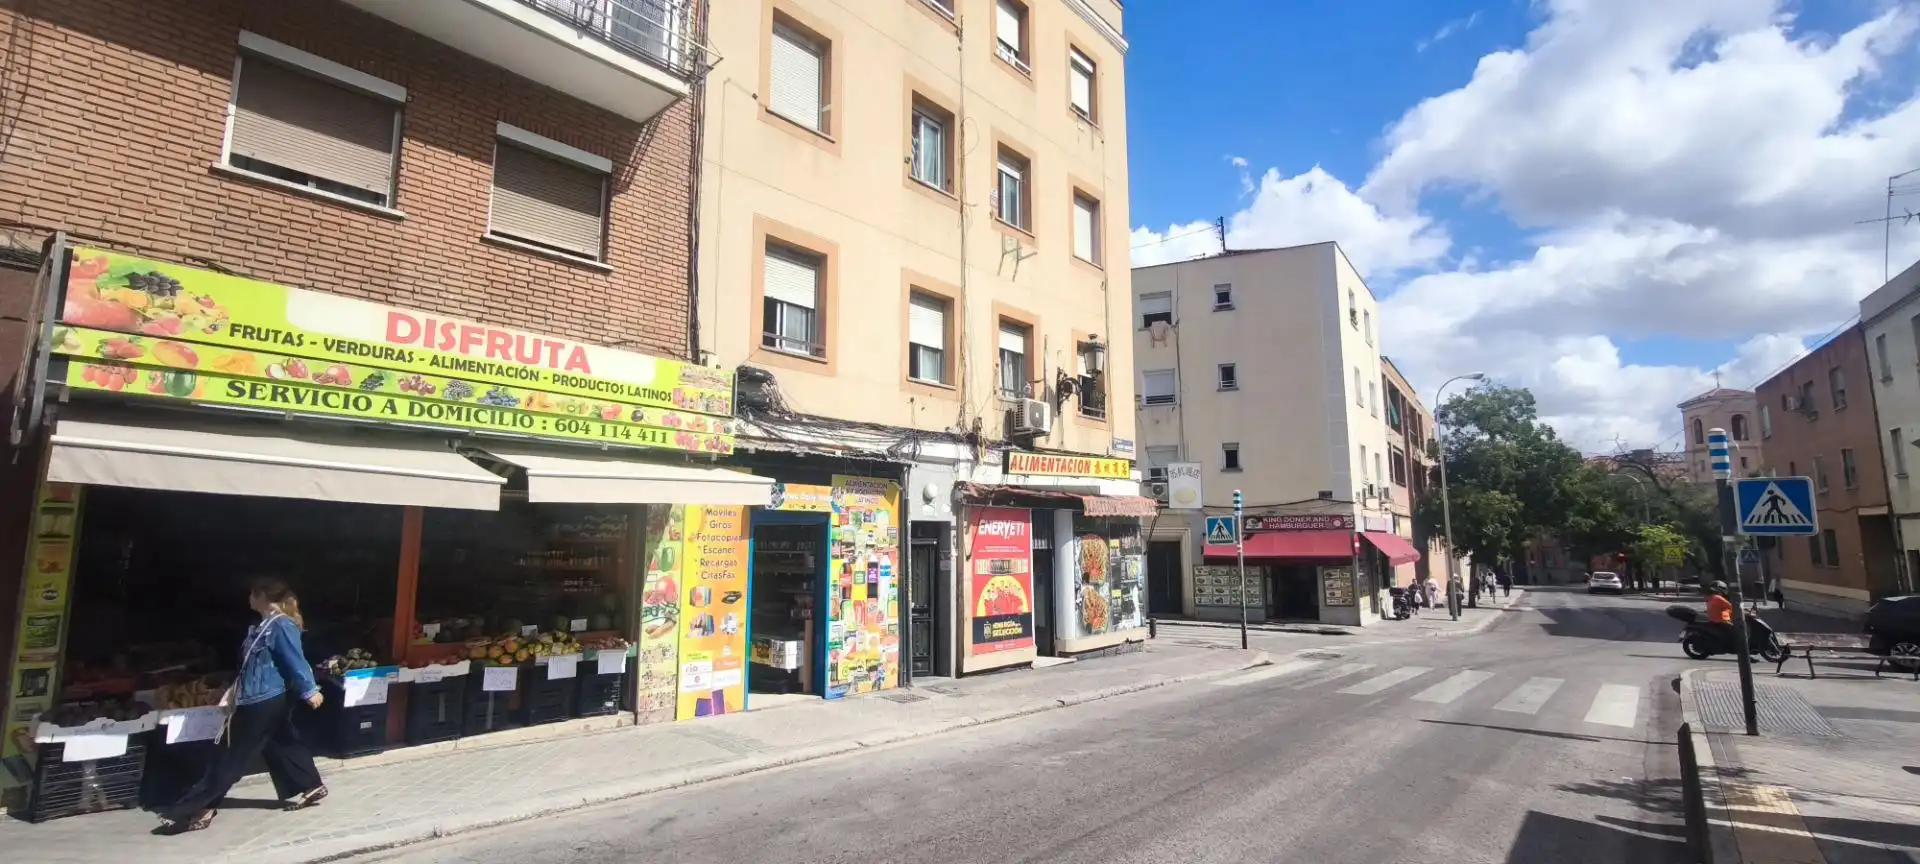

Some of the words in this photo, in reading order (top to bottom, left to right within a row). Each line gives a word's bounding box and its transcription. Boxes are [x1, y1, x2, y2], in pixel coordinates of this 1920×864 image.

[385, 310, 592, 374] DISFRUTA
[229, 322, 304, 348] FRUTAS
[323, 338, 414, 365] VERDURAS
[429, 354, 540, 383] ALIMENTACIÓN
[552, 373, 624, 396] PRODUCTOS
[626, 384, 672, 402] LATINOS
[225, 379, 373, 412] SERVICIO
[380, 399, 398, 415] A
[407, 400, 535, 429] DOMICILIO
[554, 417, 592, 435] 604
[599, 424, 631, 440] 114
[636, 428, 668, 445] 411
[1010, 454, 1092, 475] ALIMENTACION
[705, 508, 737, 517] Moviles
[709, 520, 732, 529] Giros
[978, 519, 1025, 541] ENERYETI
[697, 532, 745, 543] Fotocopias
[703, 545, 736, 554] Escaner
[700, 558, 738, 568] Recargas
